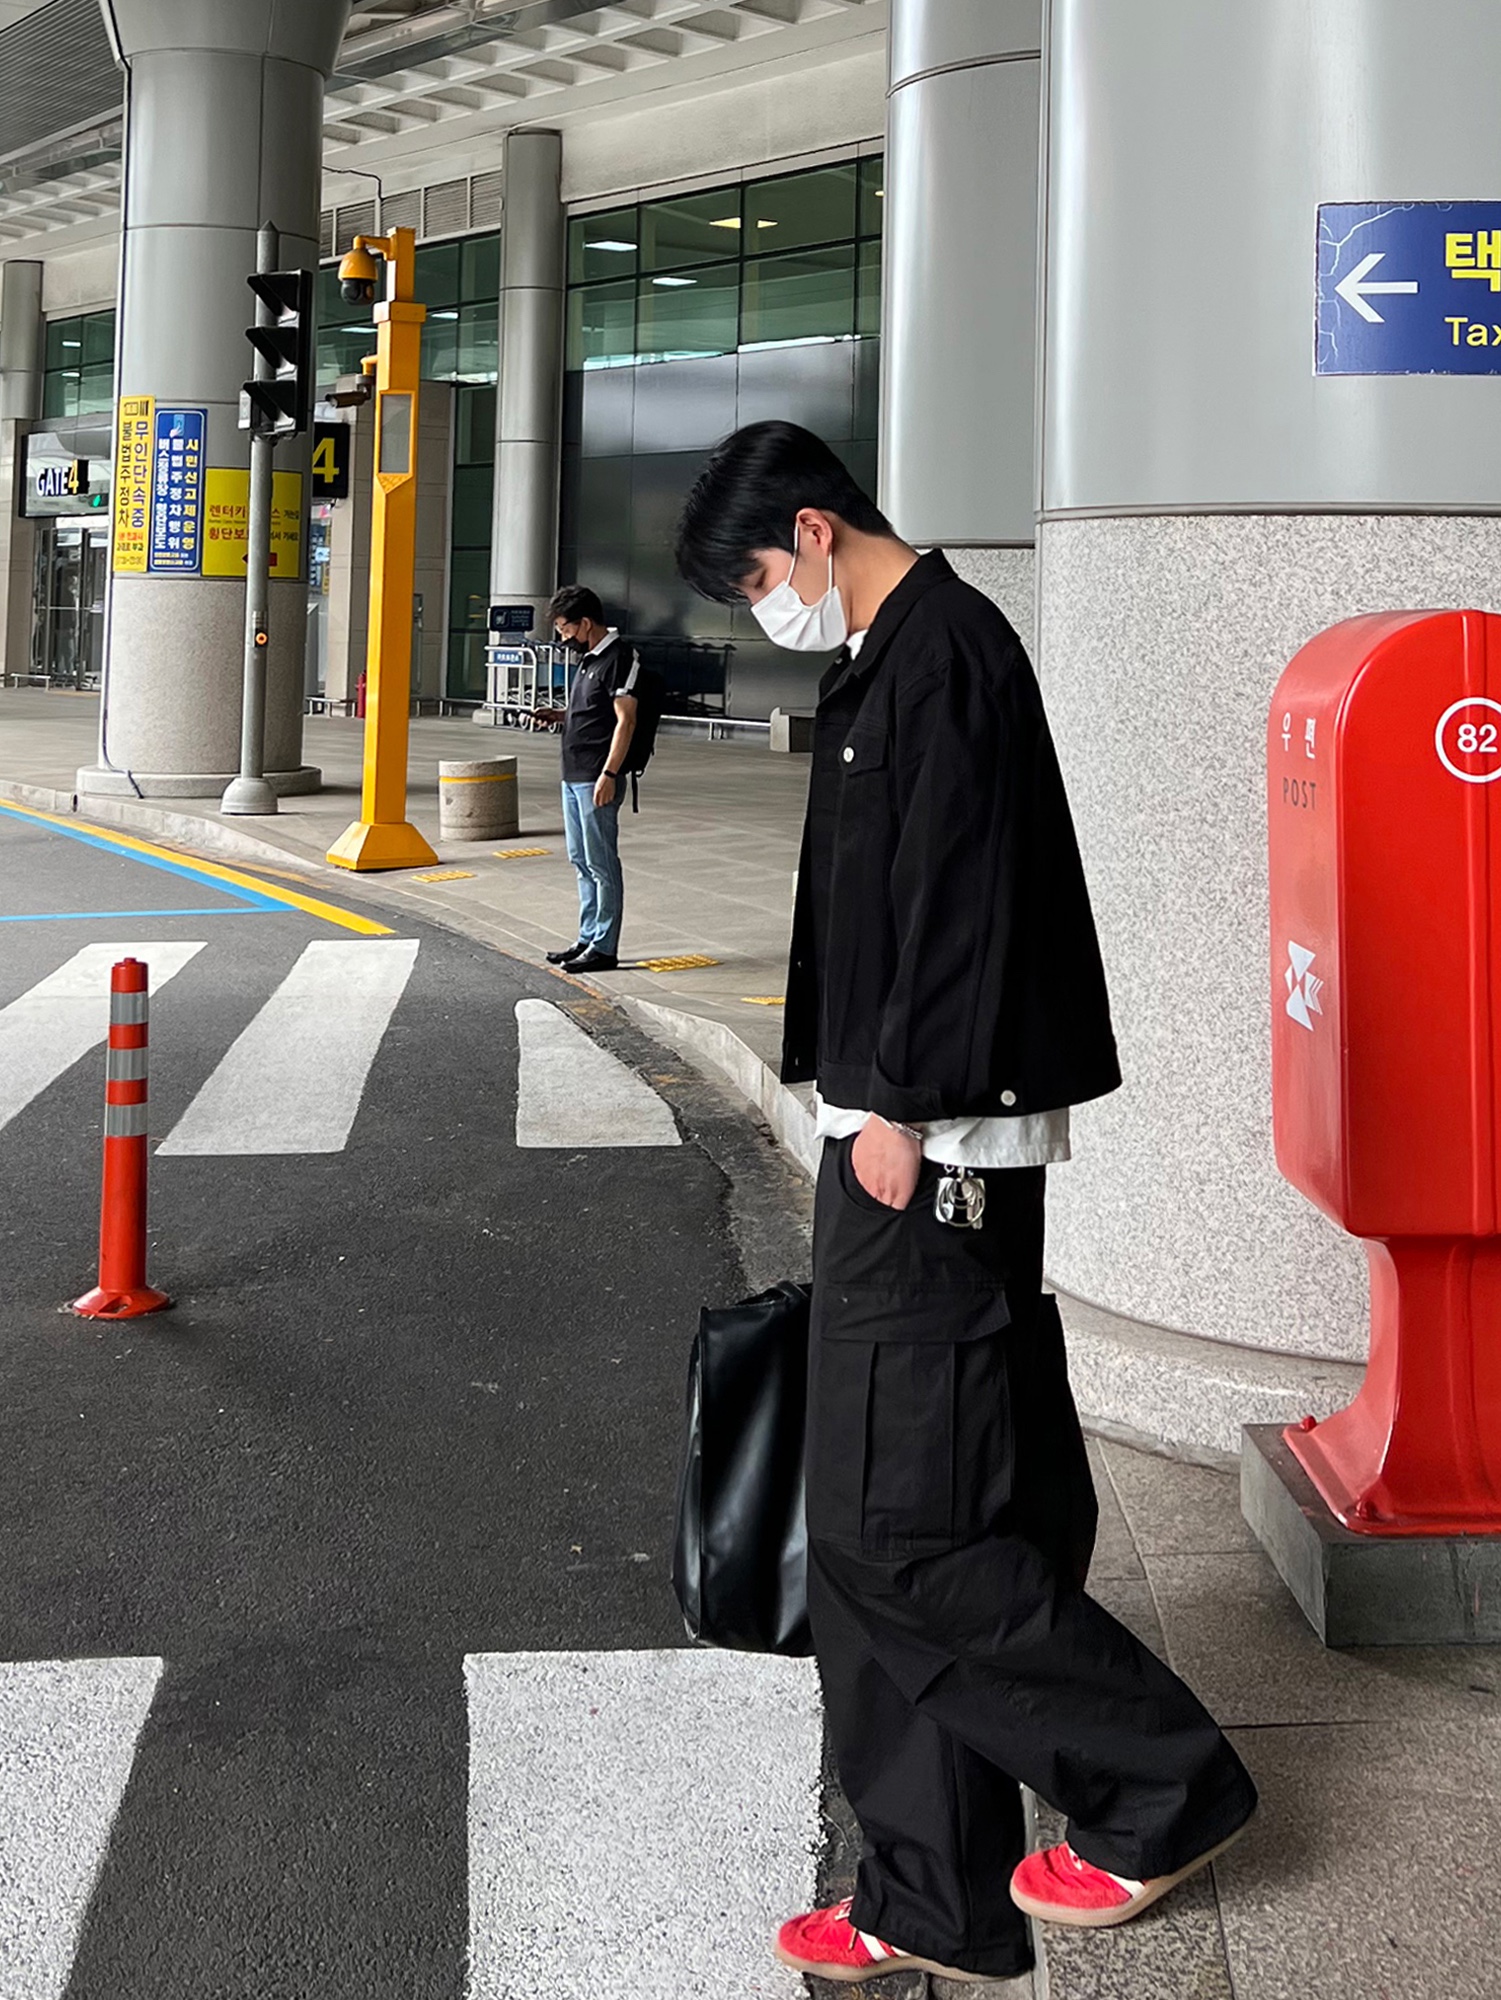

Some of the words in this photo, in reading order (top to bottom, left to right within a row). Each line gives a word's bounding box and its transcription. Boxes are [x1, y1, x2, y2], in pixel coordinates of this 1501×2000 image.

[131, 420, 149, 529] 무인단속중
[312, 437, 340, 484] 4
[1457, 723, 1498, 754] 82
[1282, 776, 1317, 811] POST
